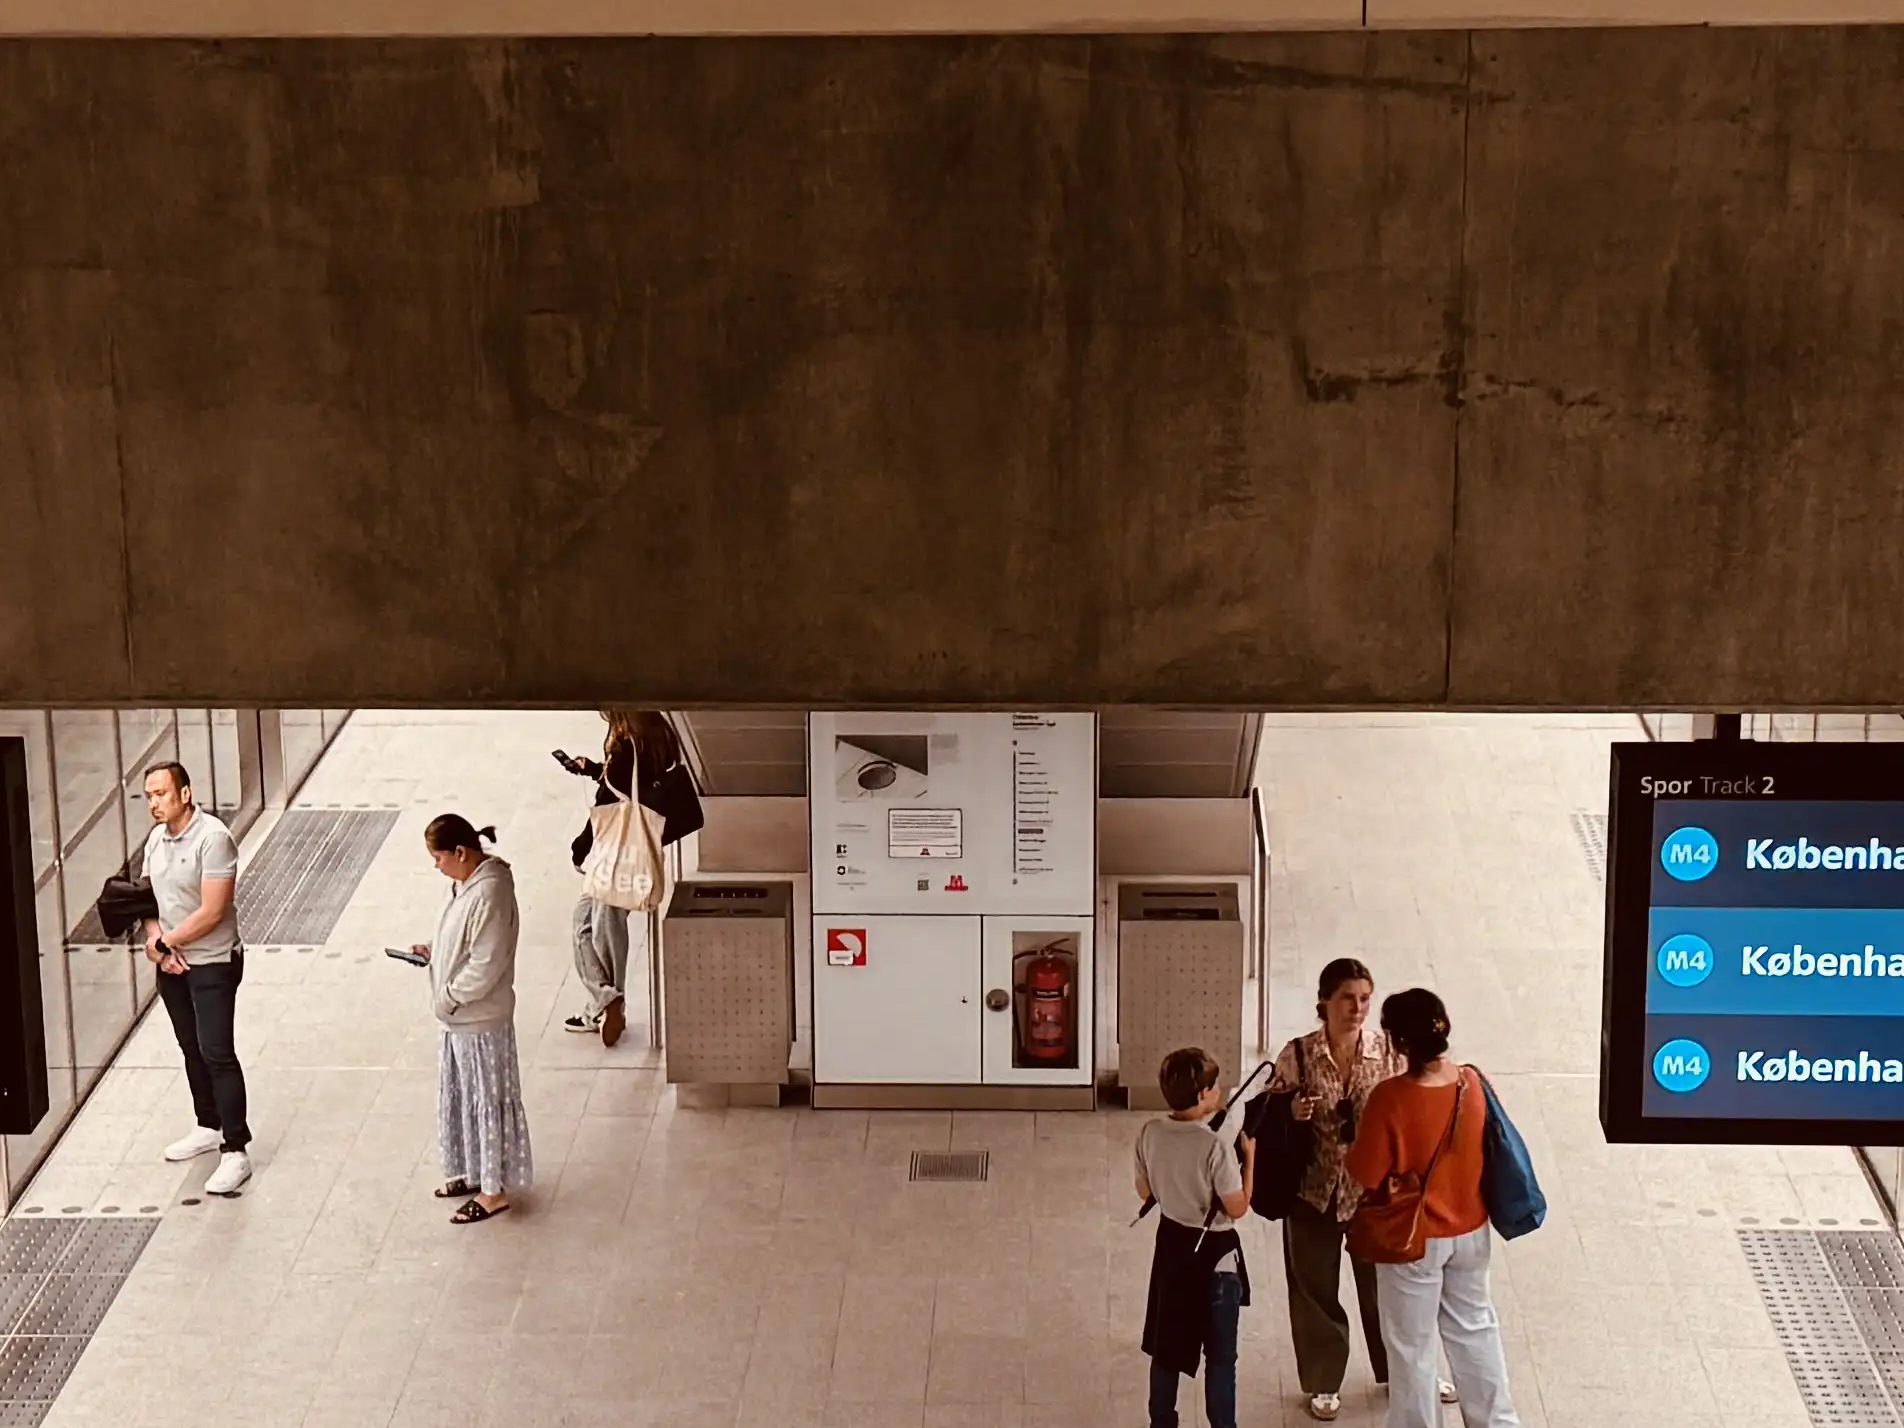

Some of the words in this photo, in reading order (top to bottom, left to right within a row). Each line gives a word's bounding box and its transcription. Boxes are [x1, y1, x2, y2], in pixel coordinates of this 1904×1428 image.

[1640, 776, 1693, 799] Spor
[1700, 776, 1756, 795] Track
[1761, 776, 1776, 795] 2
[1669, 843, 1711, 865] M4
[1666, 949, 1708, 971] M4
[1662, 1054, 1704, 1076] M4
